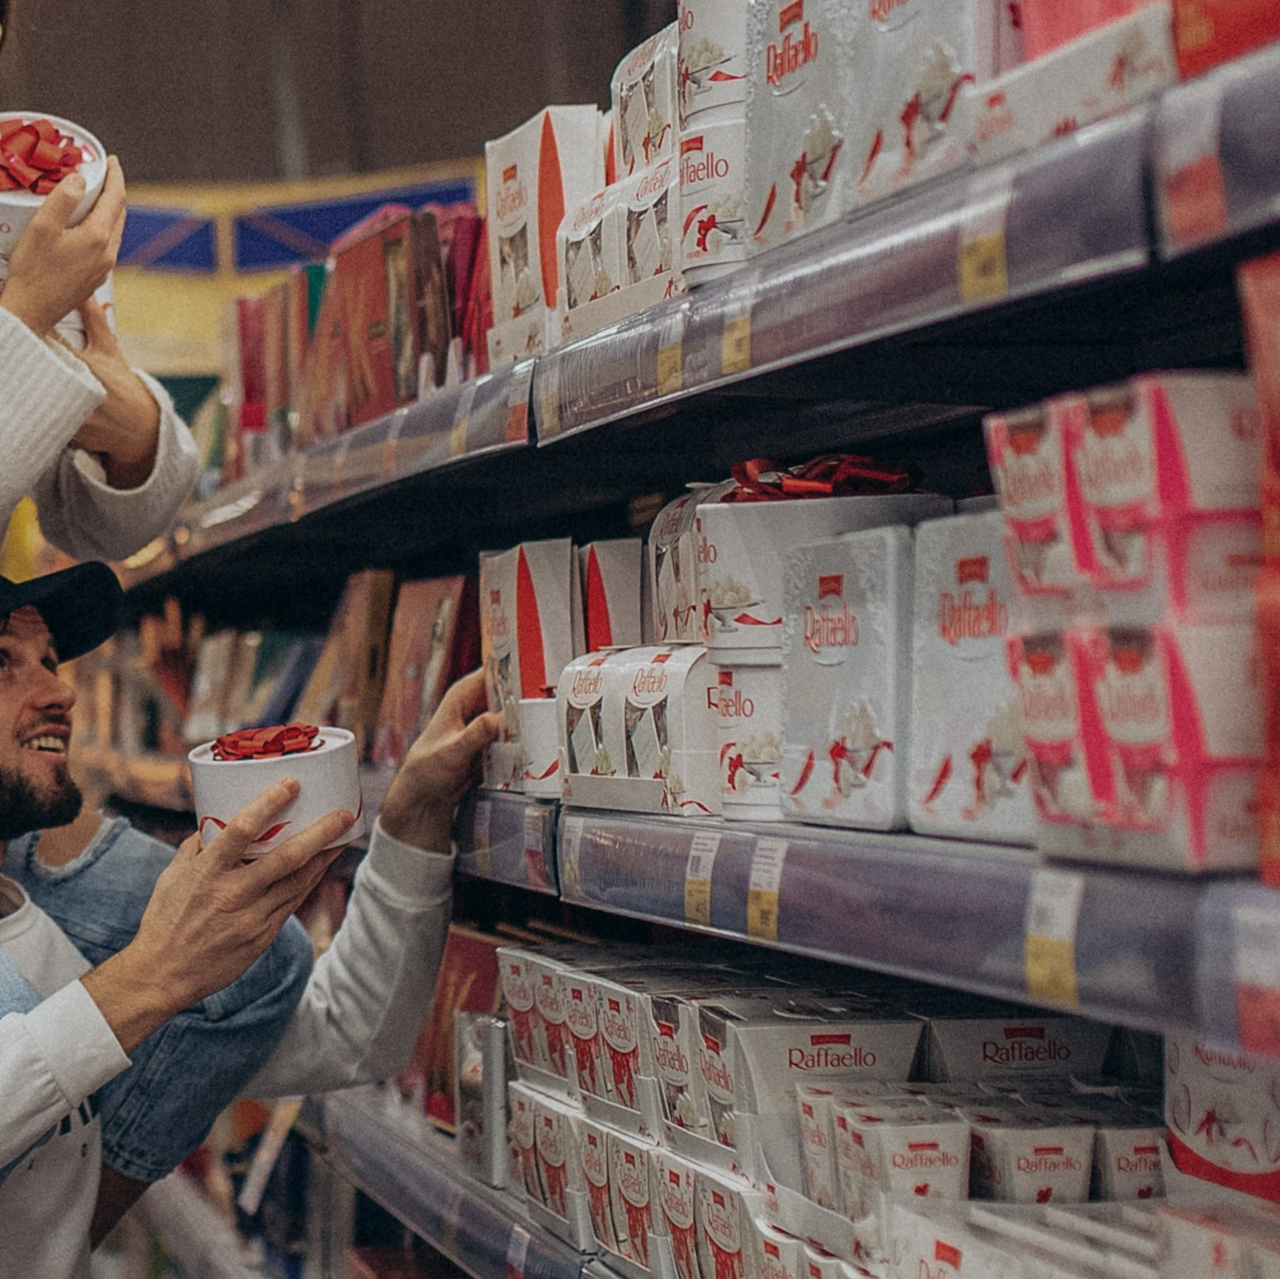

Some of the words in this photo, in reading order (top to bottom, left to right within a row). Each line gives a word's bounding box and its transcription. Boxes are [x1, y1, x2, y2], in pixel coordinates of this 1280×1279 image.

[766, 21, 818, 85] Raffaello
[680, 152, 729, 185] ffaello
[804, 603, 859, 653] Raffaello
[939, 589, 1008, 647] Raffaello
[571, 670, 602, 696] Raffaello
[632, 668, 668, 697] Raffaello
[654, 1036, 688, 1073] Raffaello
[788, 1047, 877, 1071] Raffaello
[983, 1041, 1070, 1065] Raffaello
[700, 1048, 733, 1094] Raffaello
[892, 1152, 959, 1170] Raffaello
[1017, 1155, 1082, 1173] Raffaello
